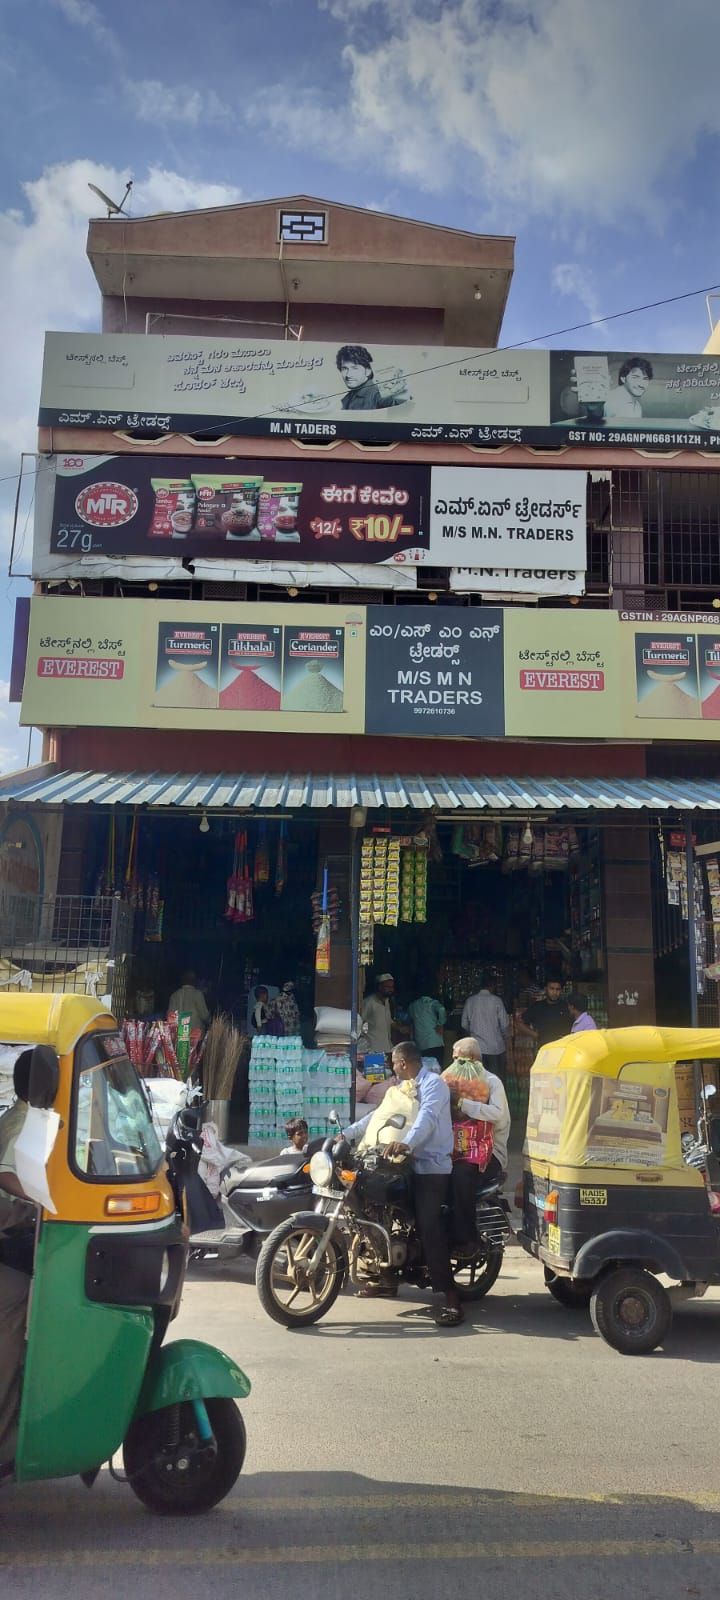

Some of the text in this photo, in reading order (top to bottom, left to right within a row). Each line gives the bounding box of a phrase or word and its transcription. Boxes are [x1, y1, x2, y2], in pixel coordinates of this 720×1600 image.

[270, 422, 337, 436] M.N TADERS
[568, 431, 587, 442] GST
[589, 432, 606, 443] NO:
[608, 433, 701, 445] 29AGNPN6681K1ZH
[322, 484, 410, 506] ಈಗ ಕೇವಲ
[86, 493, 128, 516] MTR
[350, 515, 413, 541] ₹10/-
[442, 526, 575, 542] M/S M.N. TRADERS
[56, 529, 93, 553] 27g
[620, 611, 653, 621] GSTIN
[168, 639, 211, 650] Turmeric
[231, 640, 273, 652] Tikhalal
[291, 640, 337, 652] Coriander
[645, 650, 688, 660] Turmeric
[42, 658, 120, 677] EVEREST
[397, 670, 472, 686] M/S M N
[523, 671, 600, 689] EVEREST
[387, 689, 483, 705] TRADERS
